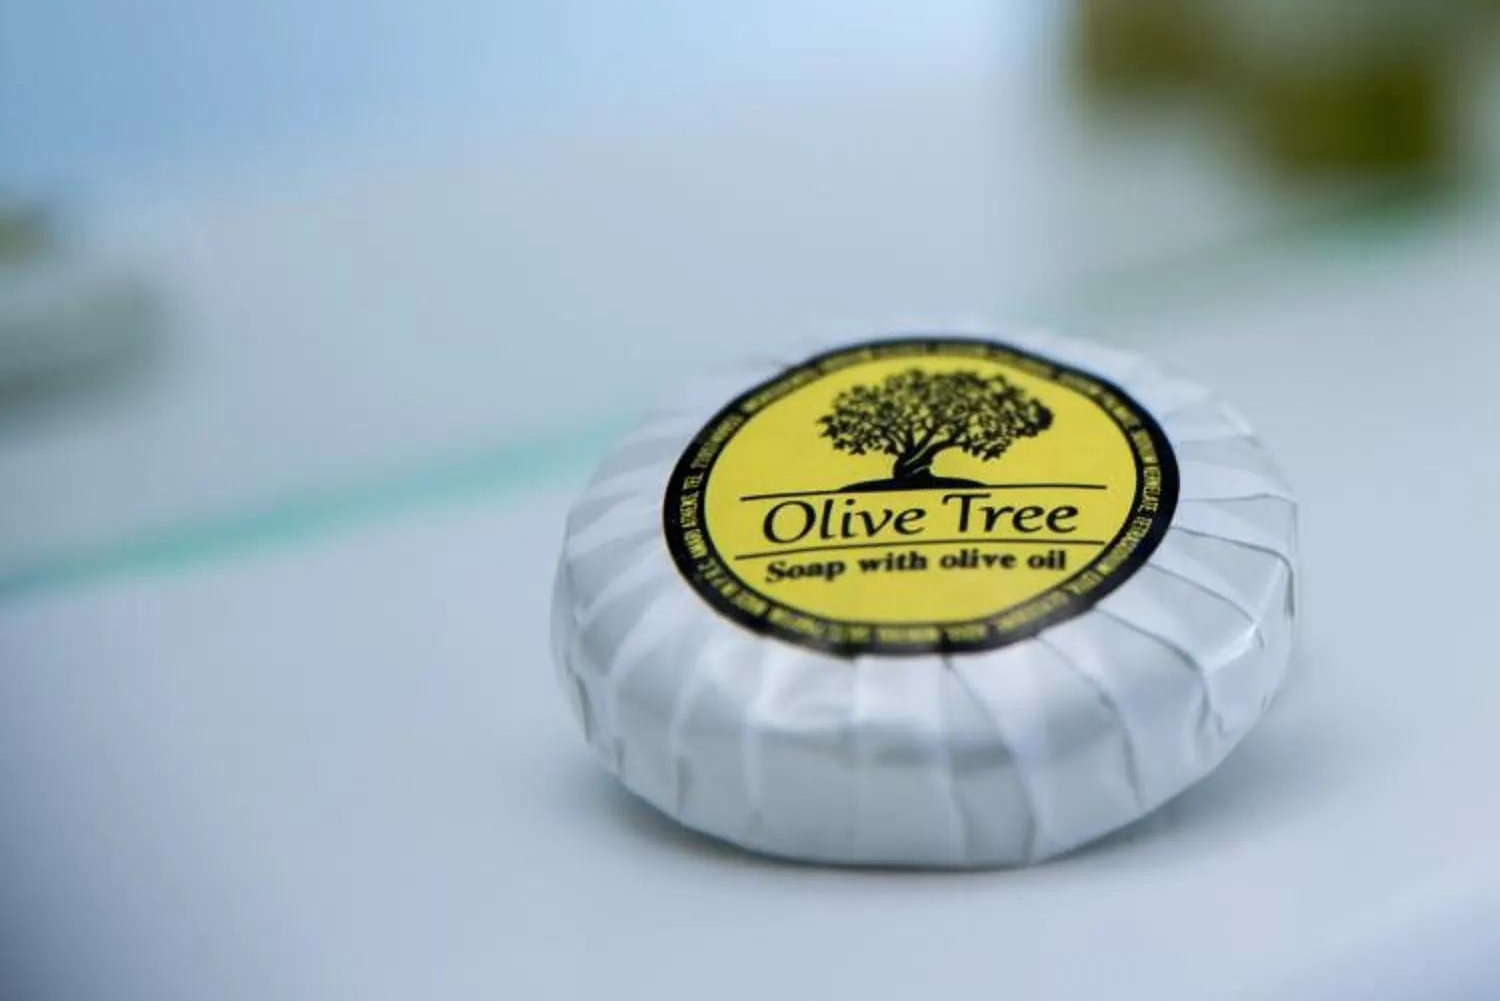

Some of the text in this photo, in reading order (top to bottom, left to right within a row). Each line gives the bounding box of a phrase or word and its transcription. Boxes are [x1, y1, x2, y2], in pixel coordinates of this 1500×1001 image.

[763, 493, 1079, 544] Olive Tree
[765, 548, 1066, 583] Soap with olive oil
